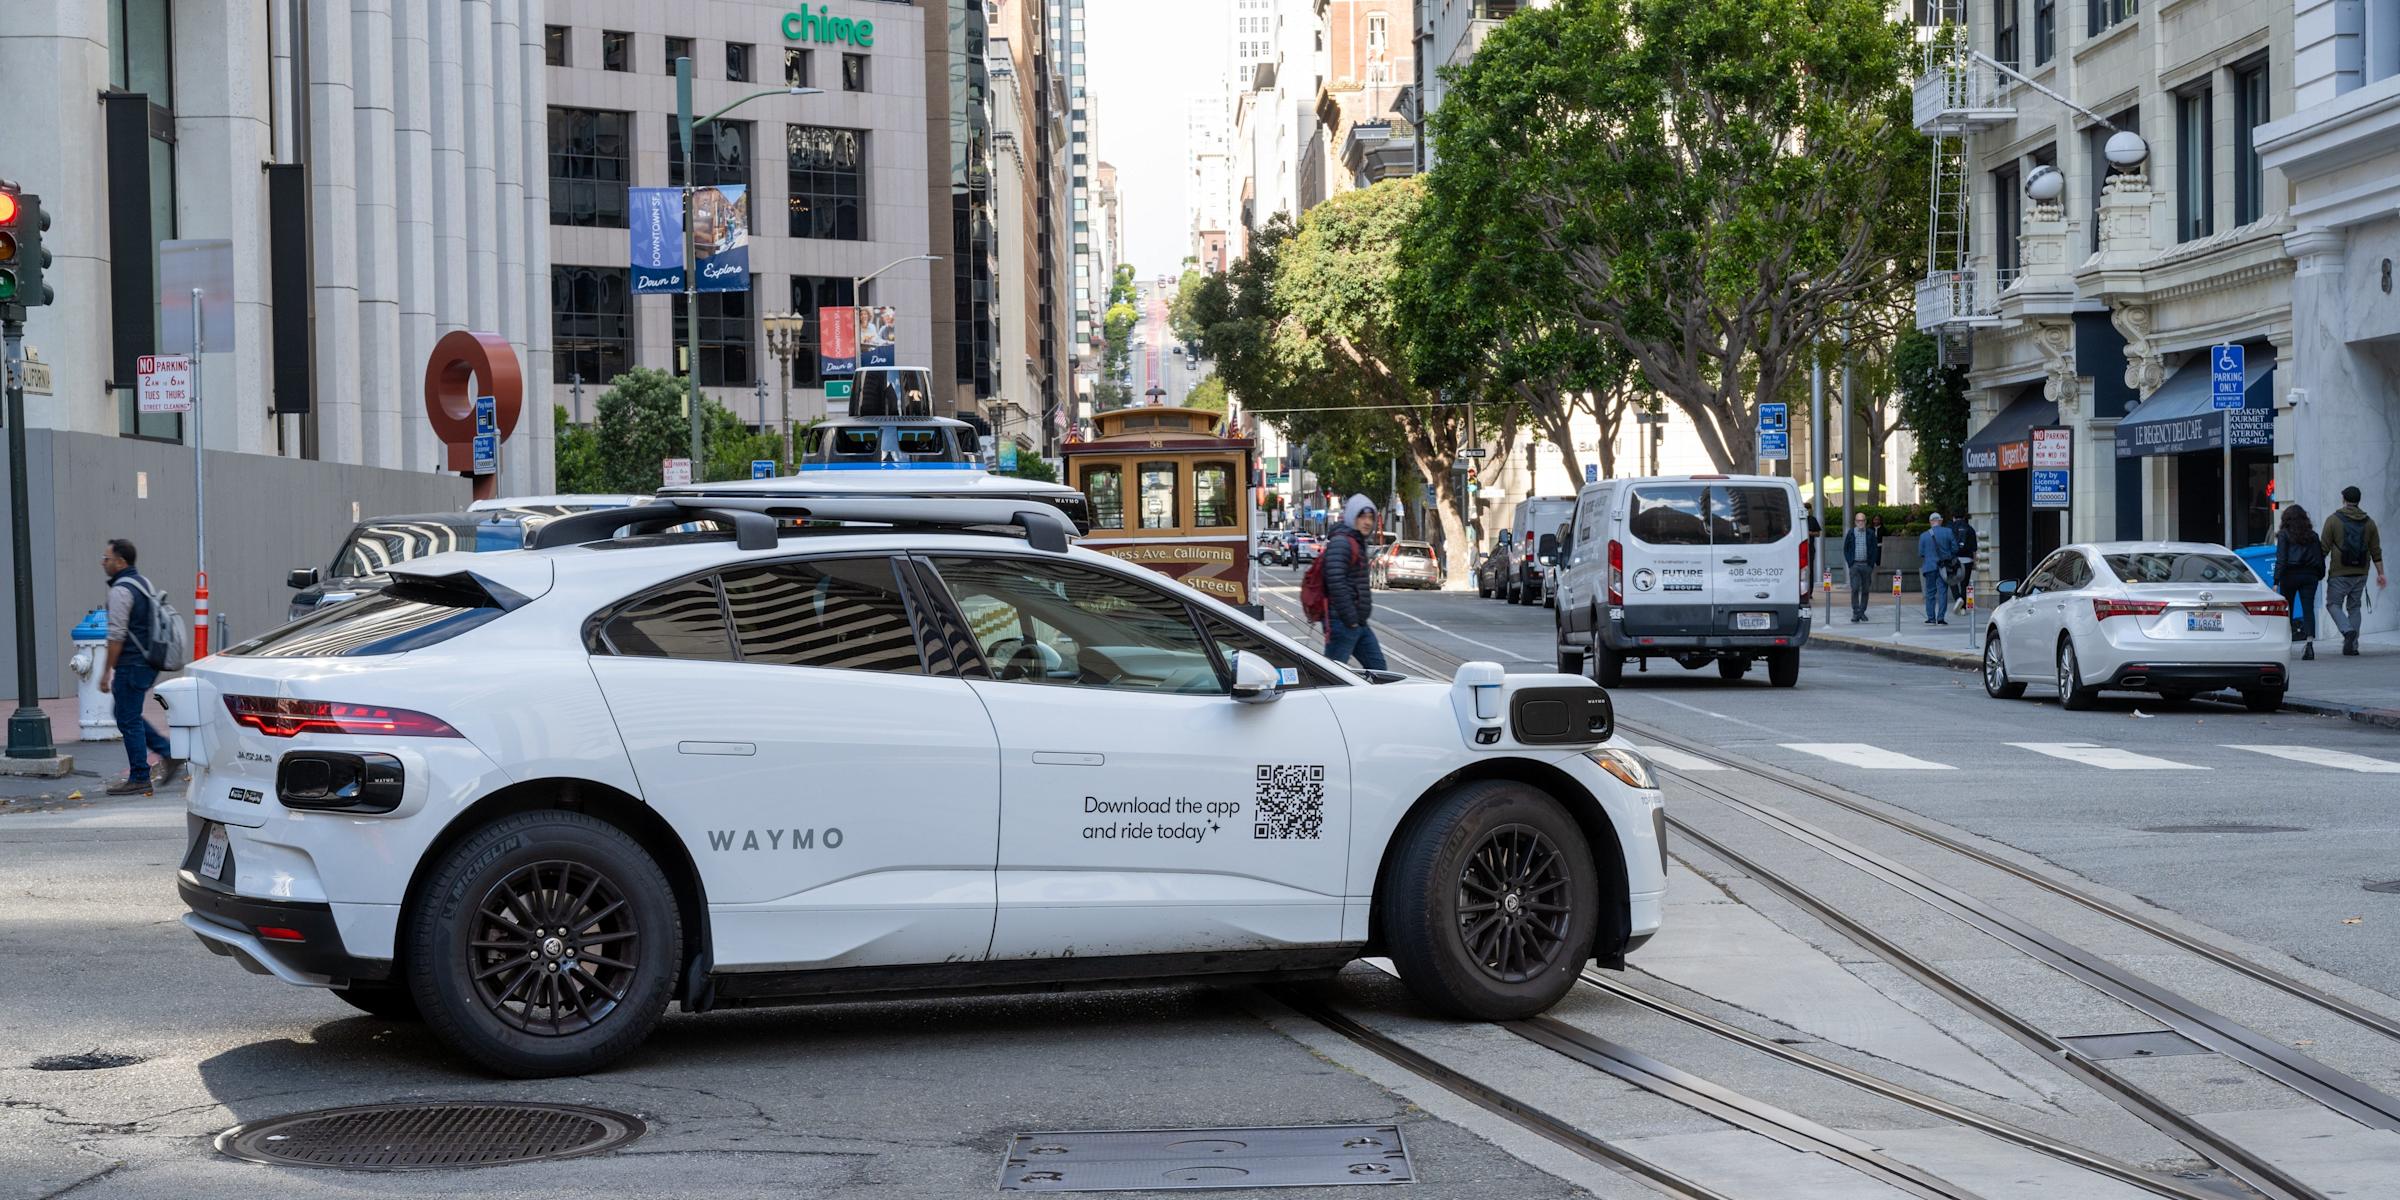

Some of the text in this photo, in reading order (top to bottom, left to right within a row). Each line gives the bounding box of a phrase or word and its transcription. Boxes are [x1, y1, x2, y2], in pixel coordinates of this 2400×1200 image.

[782, 3, 874, 47] chime
[652, 209, 661, 267] DOWNTOWN
[703, 262, 742, 279] Explore
[638, 275, 680, 289] Down to
[870, 355, 887, 364] Dine
[140, 358, 188, 373] NO PARKING
[825, 362, 846, 372] Down
[23, 368, 50, 388] ALIFORNIA
[2214, 373, 2243, 383] PARKING
[2219, 382, 2238, 393] ONLY
[145, 390, 186, 400] TUES THURS
[143, 403, 160, 411] STREET
[2230, 408, 2269, 416] REAKFAST
[2230, 415, 2264, 423] OURMET
[2230, 422, 2274, 430] ANDWICHES
[2034, 430, 2069, 441] NO PARKING
[2135, 426, 2143, 446] LE
[2143, 423, 2172, 445] REGENCY
[2172, 421, 2187, 442] DELI
[2187, 419, 2202, 440] CAFE
[2238, 437, 2267, 445] 982-4122
[2002, 443, 2019, 469] Urgent
[2035, 471, 2058, 480] Pay by
[2035, 485, 2052, 493] Plate
[1111, 549, 1139, 560] Ness
[1173, 547, 1232, 560] California
[1662, 569, 1704, 578] FUTURE
[1728, 568, 1784, 576] 408 436-1207
[1187, 578, 1236, 593] Streets
[1084, 796, 1241, 818] Download the app
[1082, 822, 1206, 844] and ride today
[707, 827, 844, 851] WAYMO
[452, 836, 520, 900] MICHELIN
